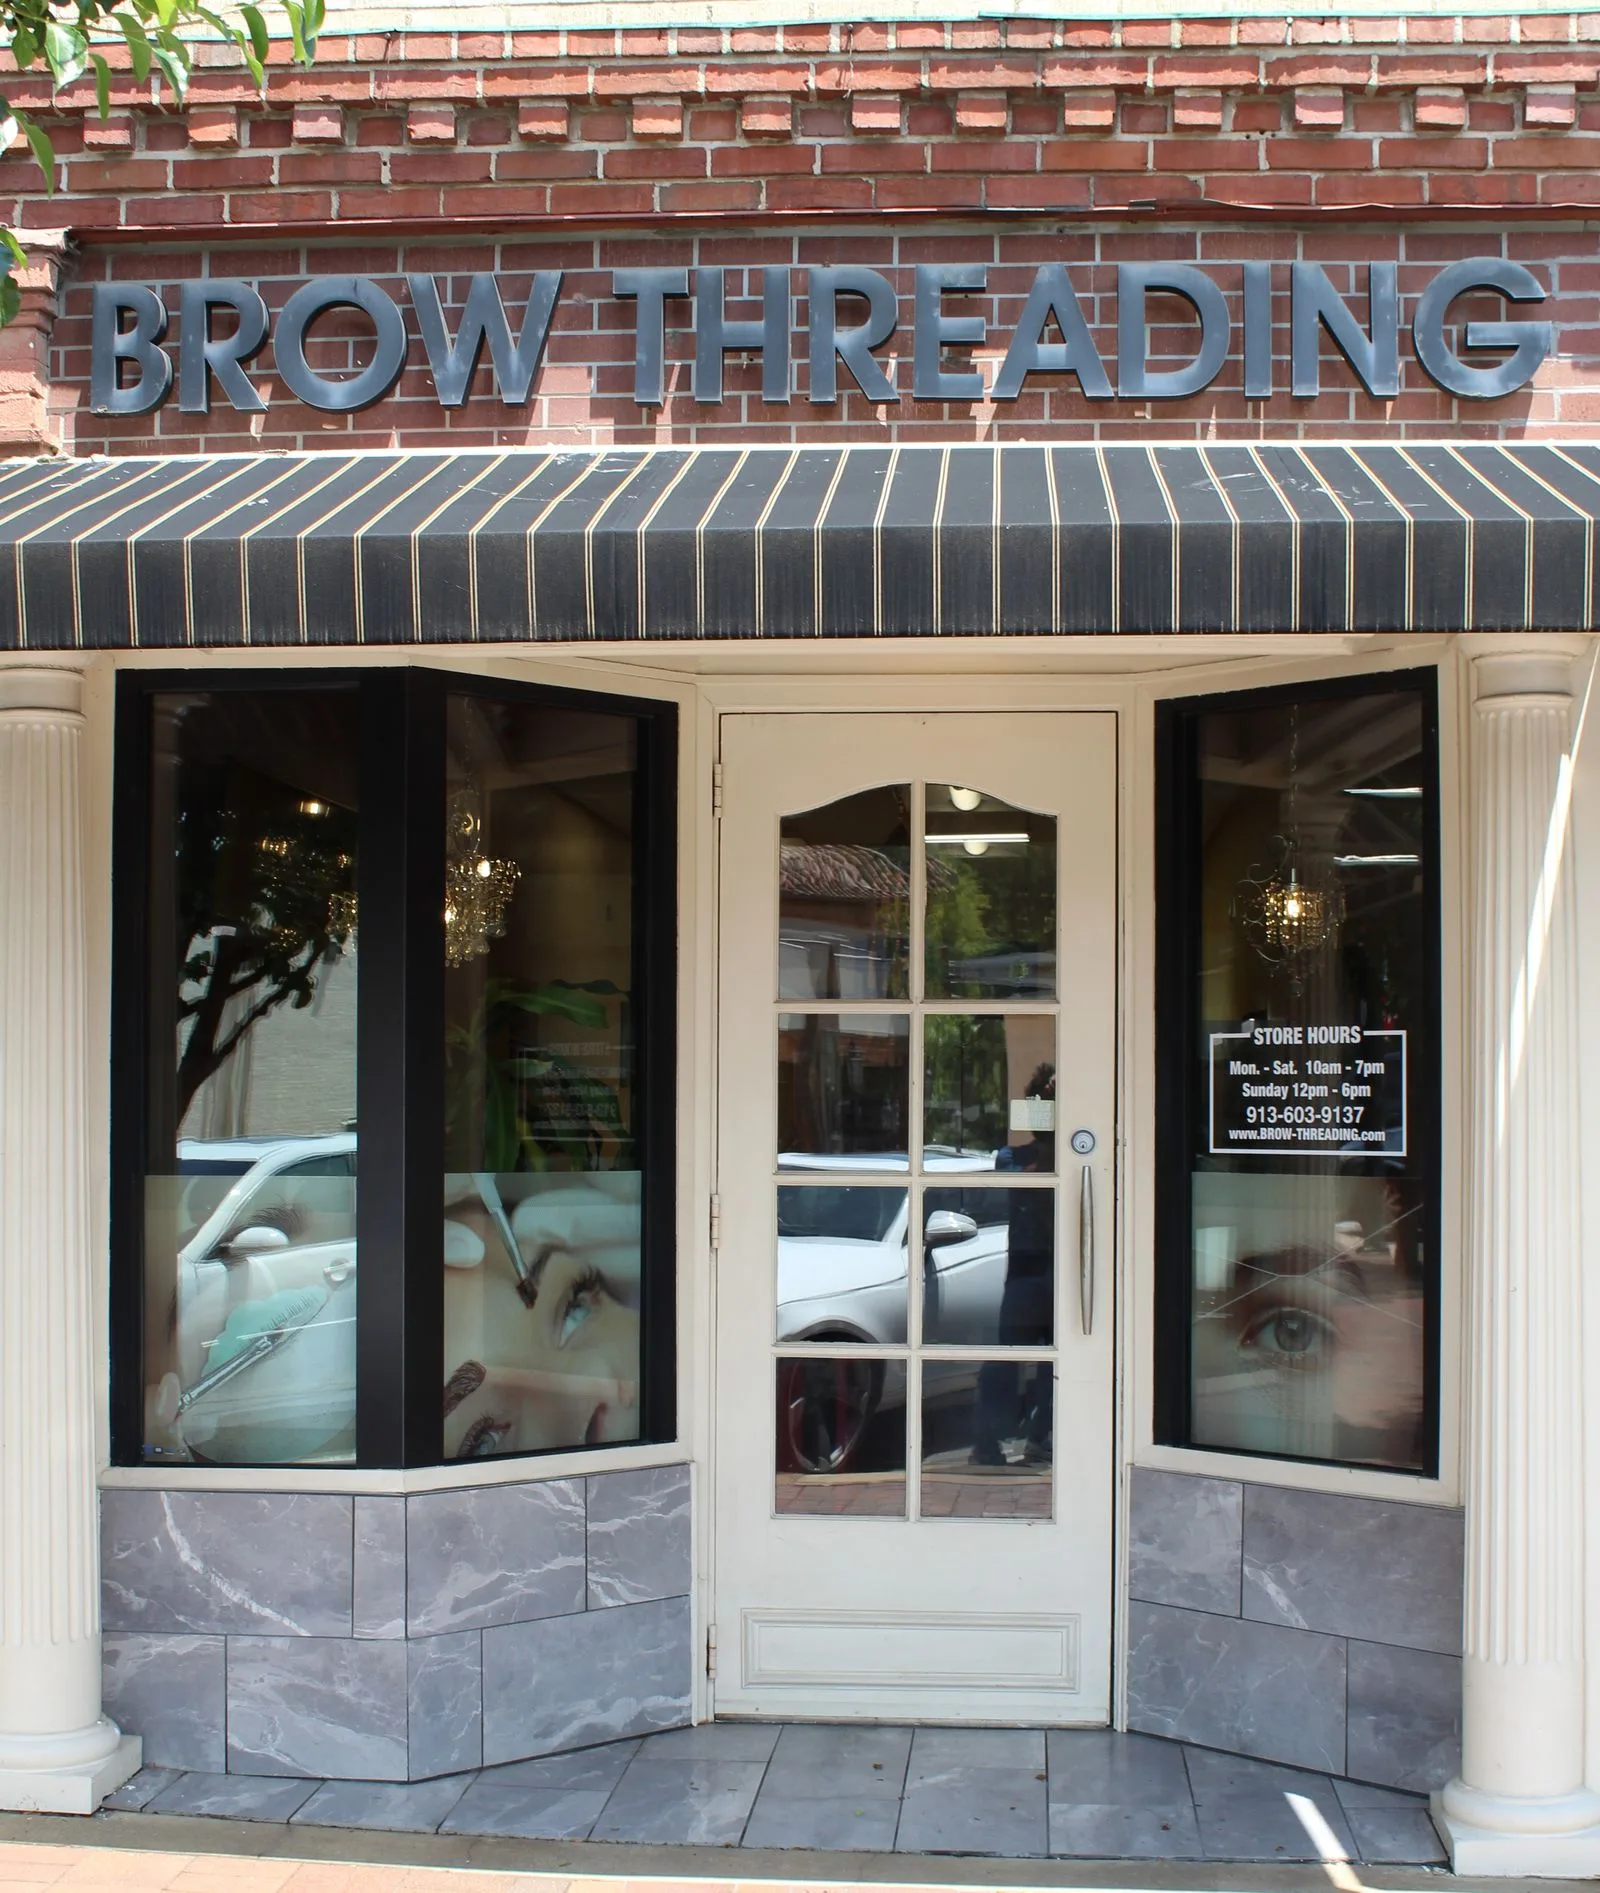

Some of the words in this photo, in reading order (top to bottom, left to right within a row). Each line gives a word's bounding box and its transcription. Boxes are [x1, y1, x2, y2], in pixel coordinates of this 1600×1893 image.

[90, 271, 563, 414] BROW
[612, 256, 1553, 406] THREADING
[1254, 1027, 1303, 1046] STORE
[1307, 1026, 1361, 1044] HOURS
[1229, 1061, 1260, 1076] Mon.
[1273, 1061, 1298, 1075] Sat.
[1305, 1060, 1342, 1075] 10am
[1355, 1059, 1385, 1077] 7pm
[1242, 1083, 1289, 1099] Sunday
[1292, 1083, 1328, 1100] 12pm
[1341, 1083, 1371, 1100] 6pm
[1246, 1106, 1364, 1124] 913-603-9137
[1229, 1127, 1386, 1142] www.BROW-THREADING.com
